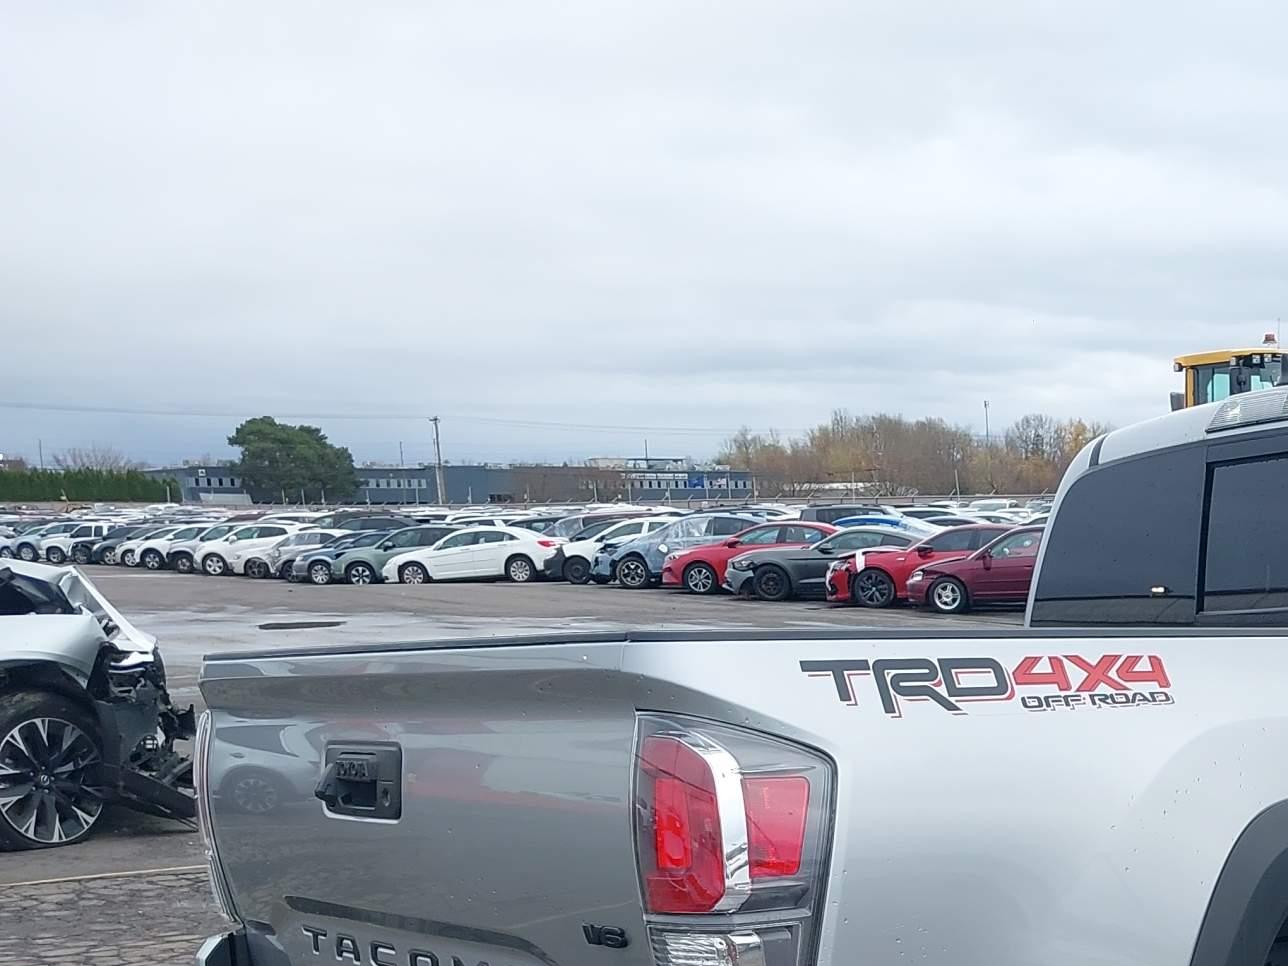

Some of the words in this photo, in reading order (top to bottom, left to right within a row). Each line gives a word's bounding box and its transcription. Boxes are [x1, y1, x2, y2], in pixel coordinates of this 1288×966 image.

[799, 657, 1015, 718] TRD
[1020, 694, 1087, 712] OFF
[1089, 690, 1175, 710] ROAD
[582, 923, 629, 949] V6
